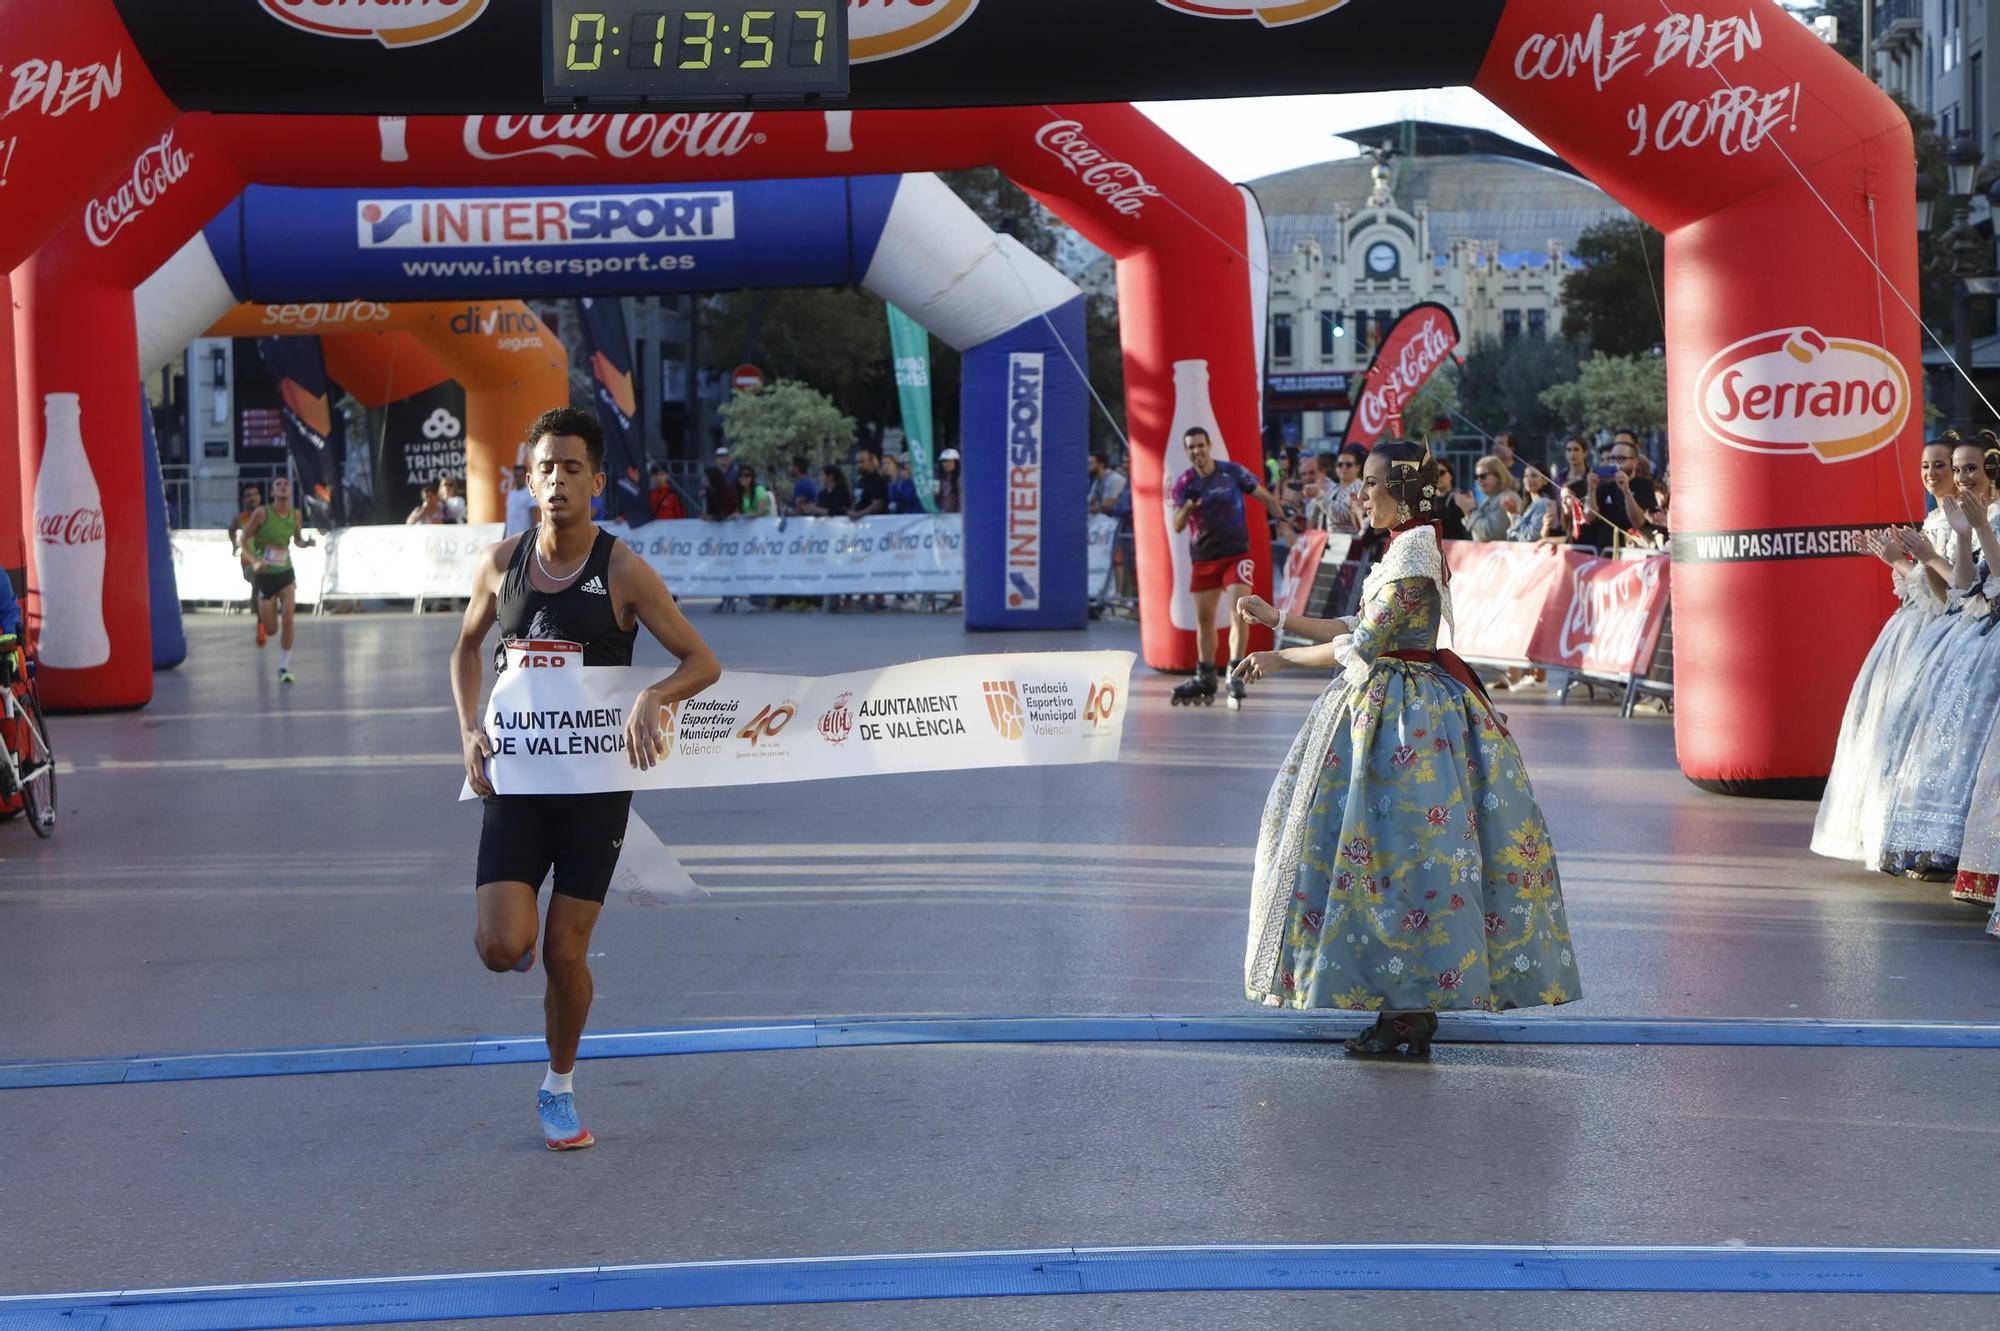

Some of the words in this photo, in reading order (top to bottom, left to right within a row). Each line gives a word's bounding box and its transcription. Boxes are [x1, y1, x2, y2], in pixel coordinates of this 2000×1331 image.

[566, 11, 826, 71] 0:13:57
[1514, 13, 1647, 92] COME
[1645, 8, 1762, 77] BIEN
[2, 48, 122, 118] BIEN
[1655, 82, 1801, 156] CORRE!
[1035, 119, 1163, 215] Coca-Cola
[84, 127, 189, 247] Coca-Cola
[421, 196, 723, 244] INTERSPORT
[403, 252, 696, 278] www.intersport.es
[262, 299, 391, 328] seguros
[450, 306, 538, 335] divina
[1715, 370, 1896, 422] Serrano
[1008, 360, 1041, 568] INTERSPORT
[580, 585, 608, 596] adidas
[1022, 681, 1069, 694] Fundació
[684, 699, 740, 711] Fundació
[859, 695, 959, 717] AJUNTAMENT
[1026, 695, 1074, 711] Esportiva
[1029, 709, 1077, 723] Municipal
[494, 708, 622, 730] AJUNTAMENT
[680, 713, 736, 728] Esportiva
[860, 724, 883, 741] DE
[886, 716, 967, 737] VALÈNCIA
[492, 737, 517, 756] DE
[525, 731, 627, 756] VALÈNCIA
[679, 726, 732, 743] Municipal
